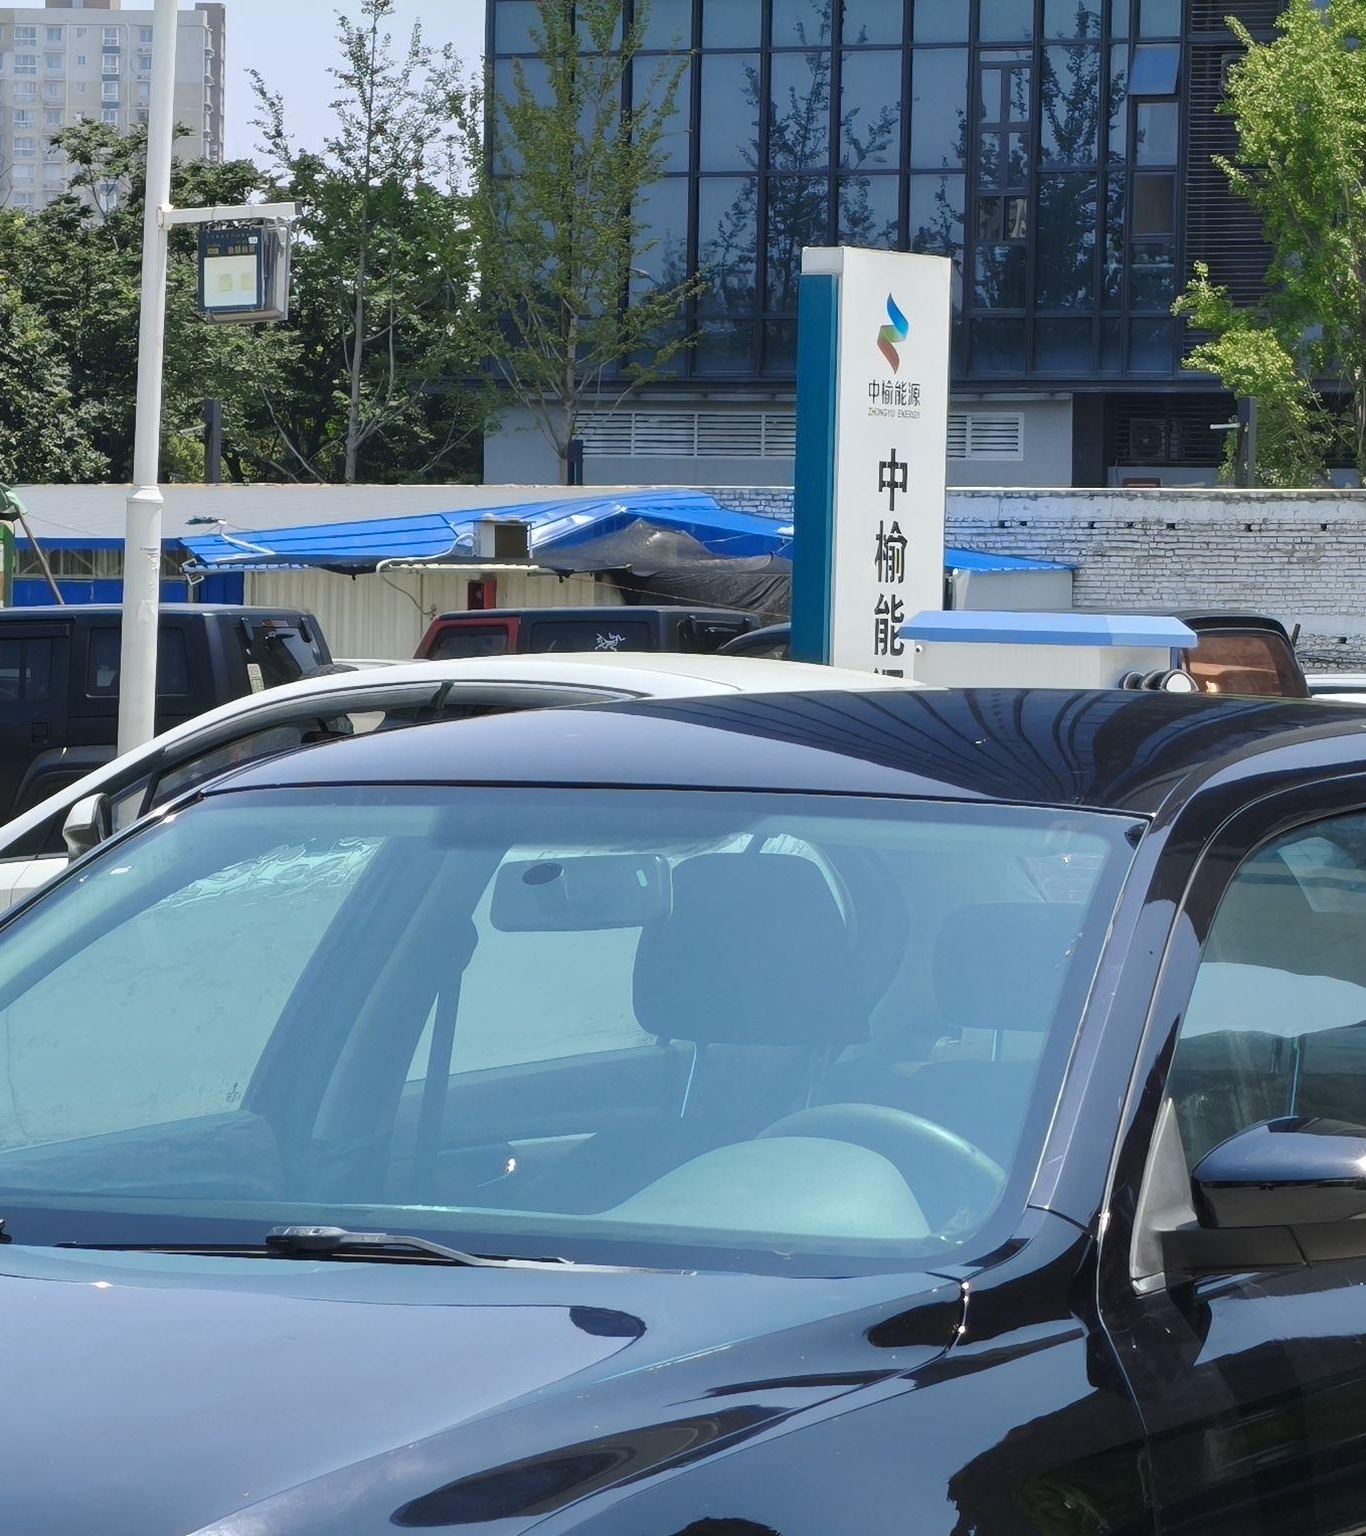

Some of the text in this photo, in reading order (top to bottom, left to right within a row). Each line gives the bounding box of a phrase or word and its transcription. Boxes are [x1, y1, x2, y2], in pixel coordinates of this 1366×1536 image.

[868, 379, 921, 407] 中榆能源
[874, 448, 908, 679] 中榆能
